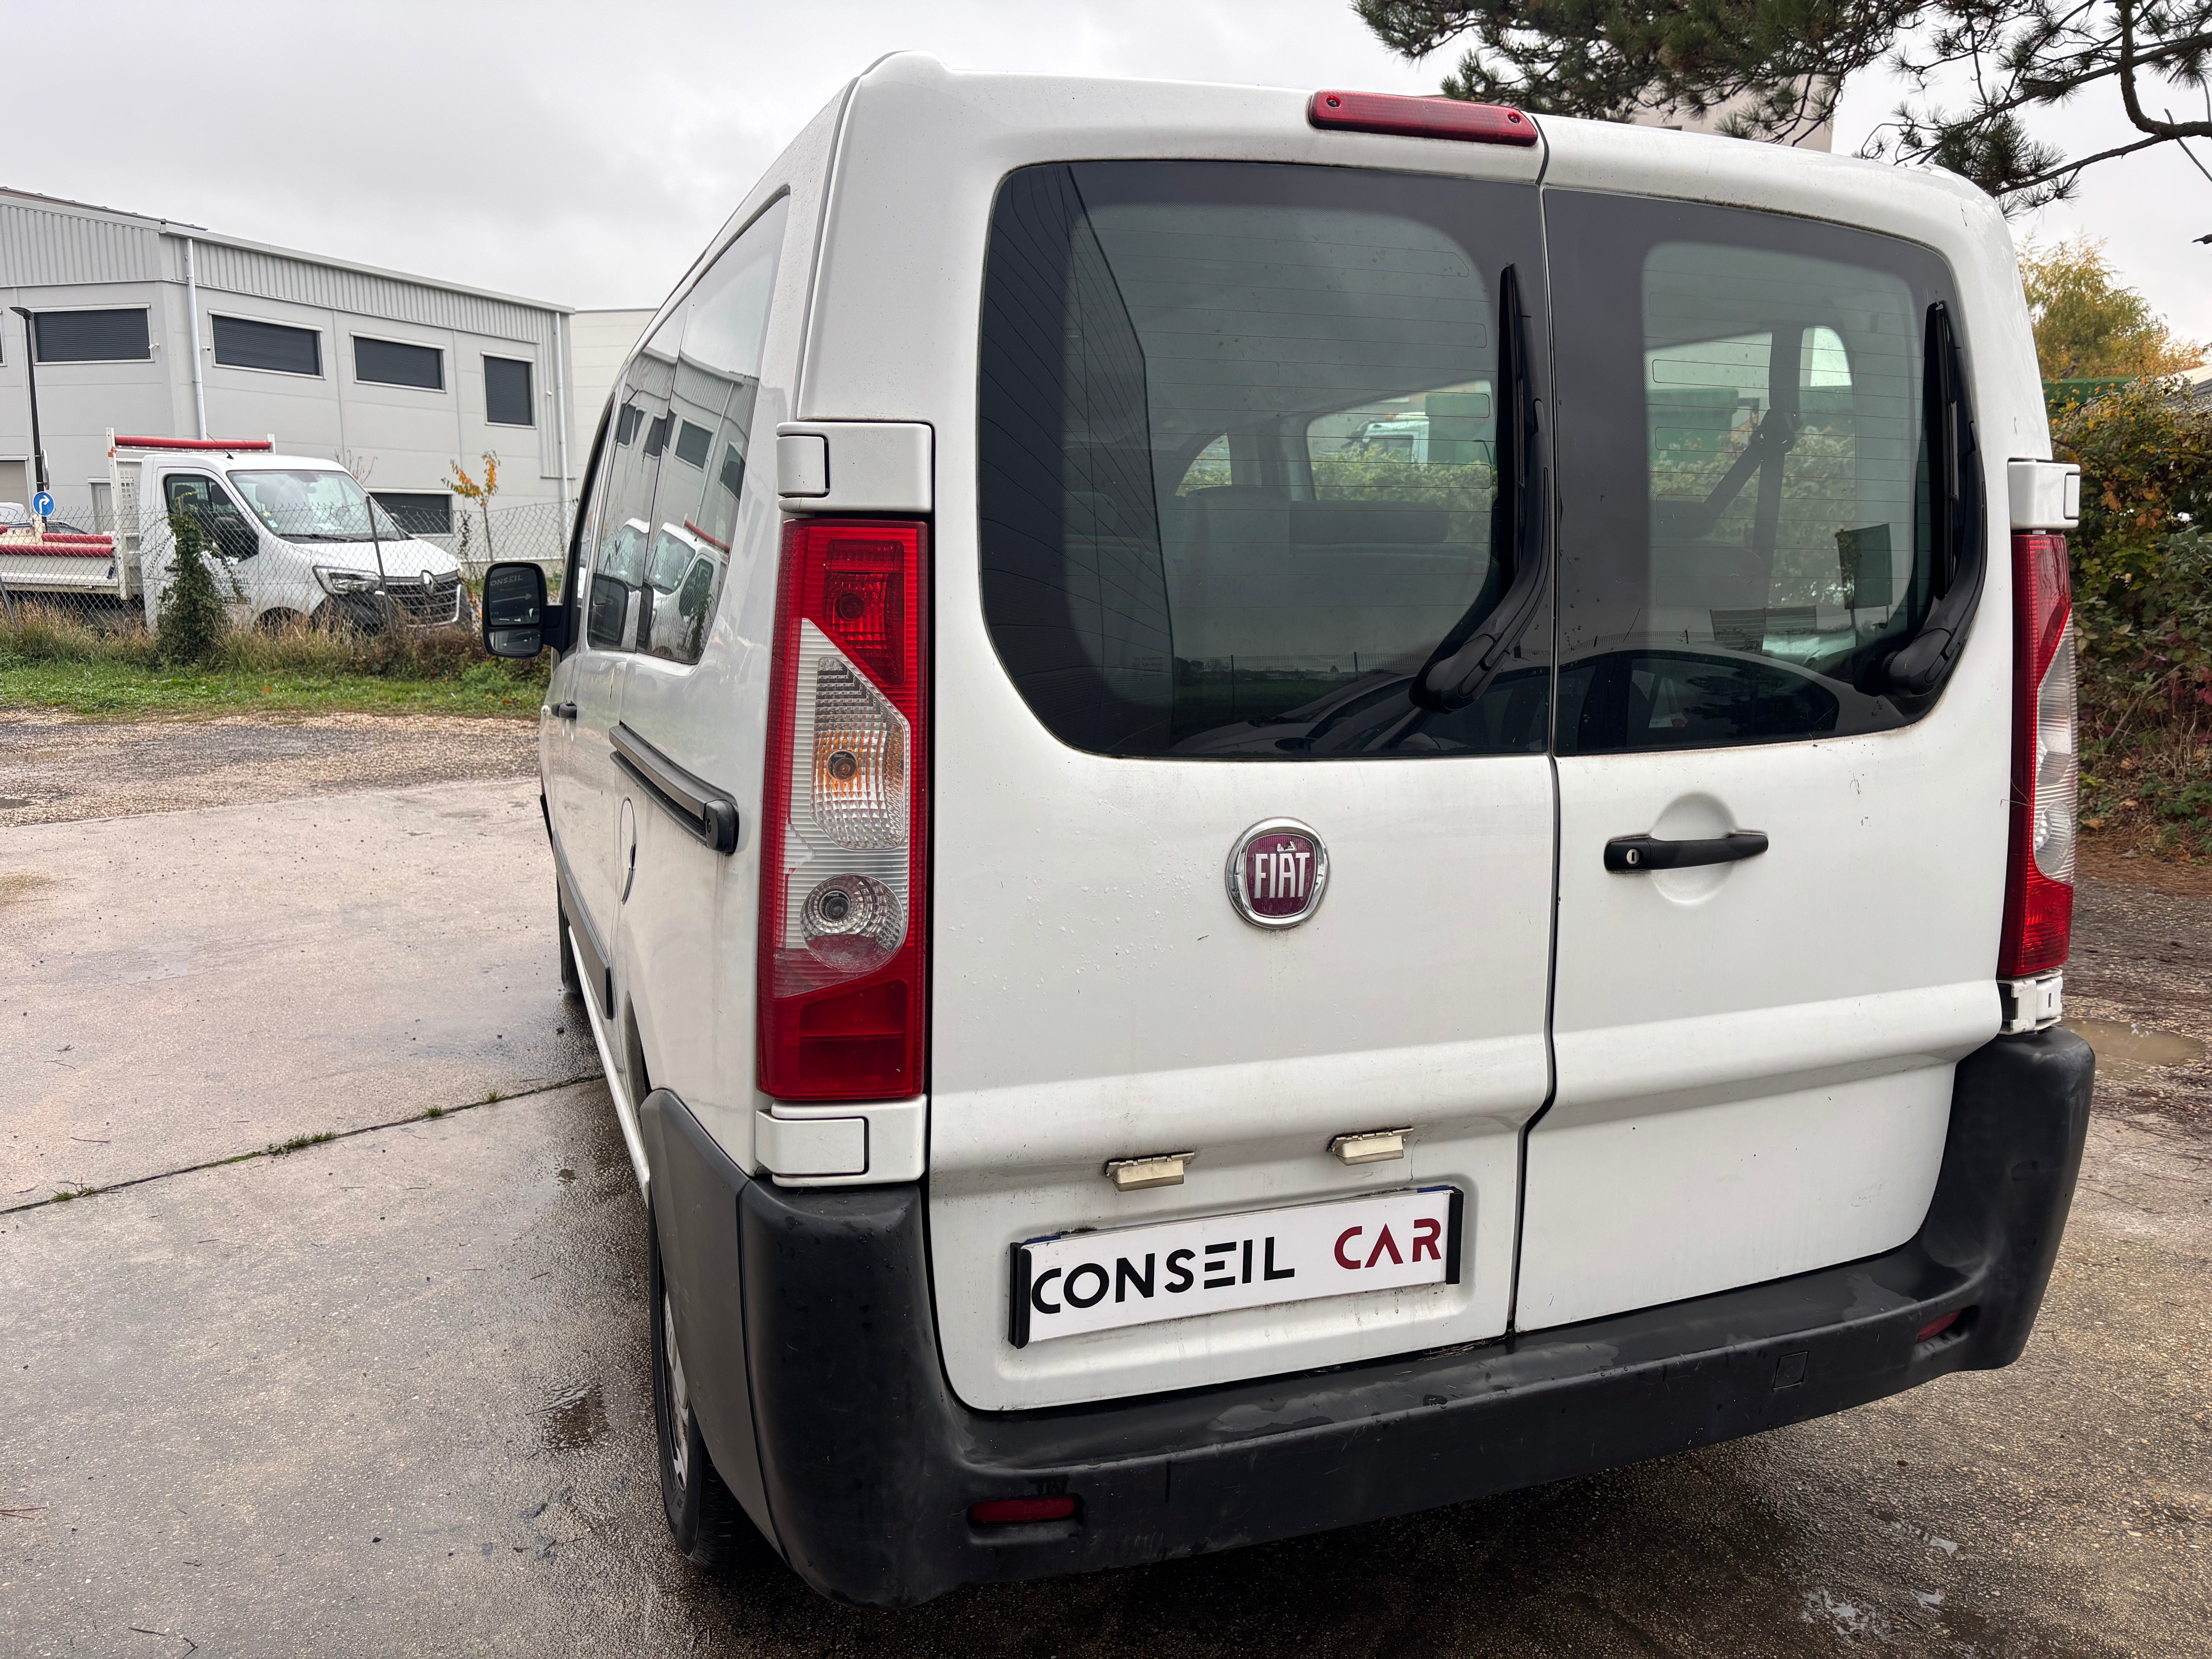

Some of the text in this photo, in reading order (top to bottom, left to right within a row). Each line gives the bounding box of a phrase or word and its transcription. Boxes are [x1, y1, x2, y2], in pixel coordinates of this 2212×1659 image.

[489, 575, 523, 586] ONSEIL
[1254, 852, 1310, 898] FIAT
[1031, 1218, 1441, 1314] CONSEIL CAR
